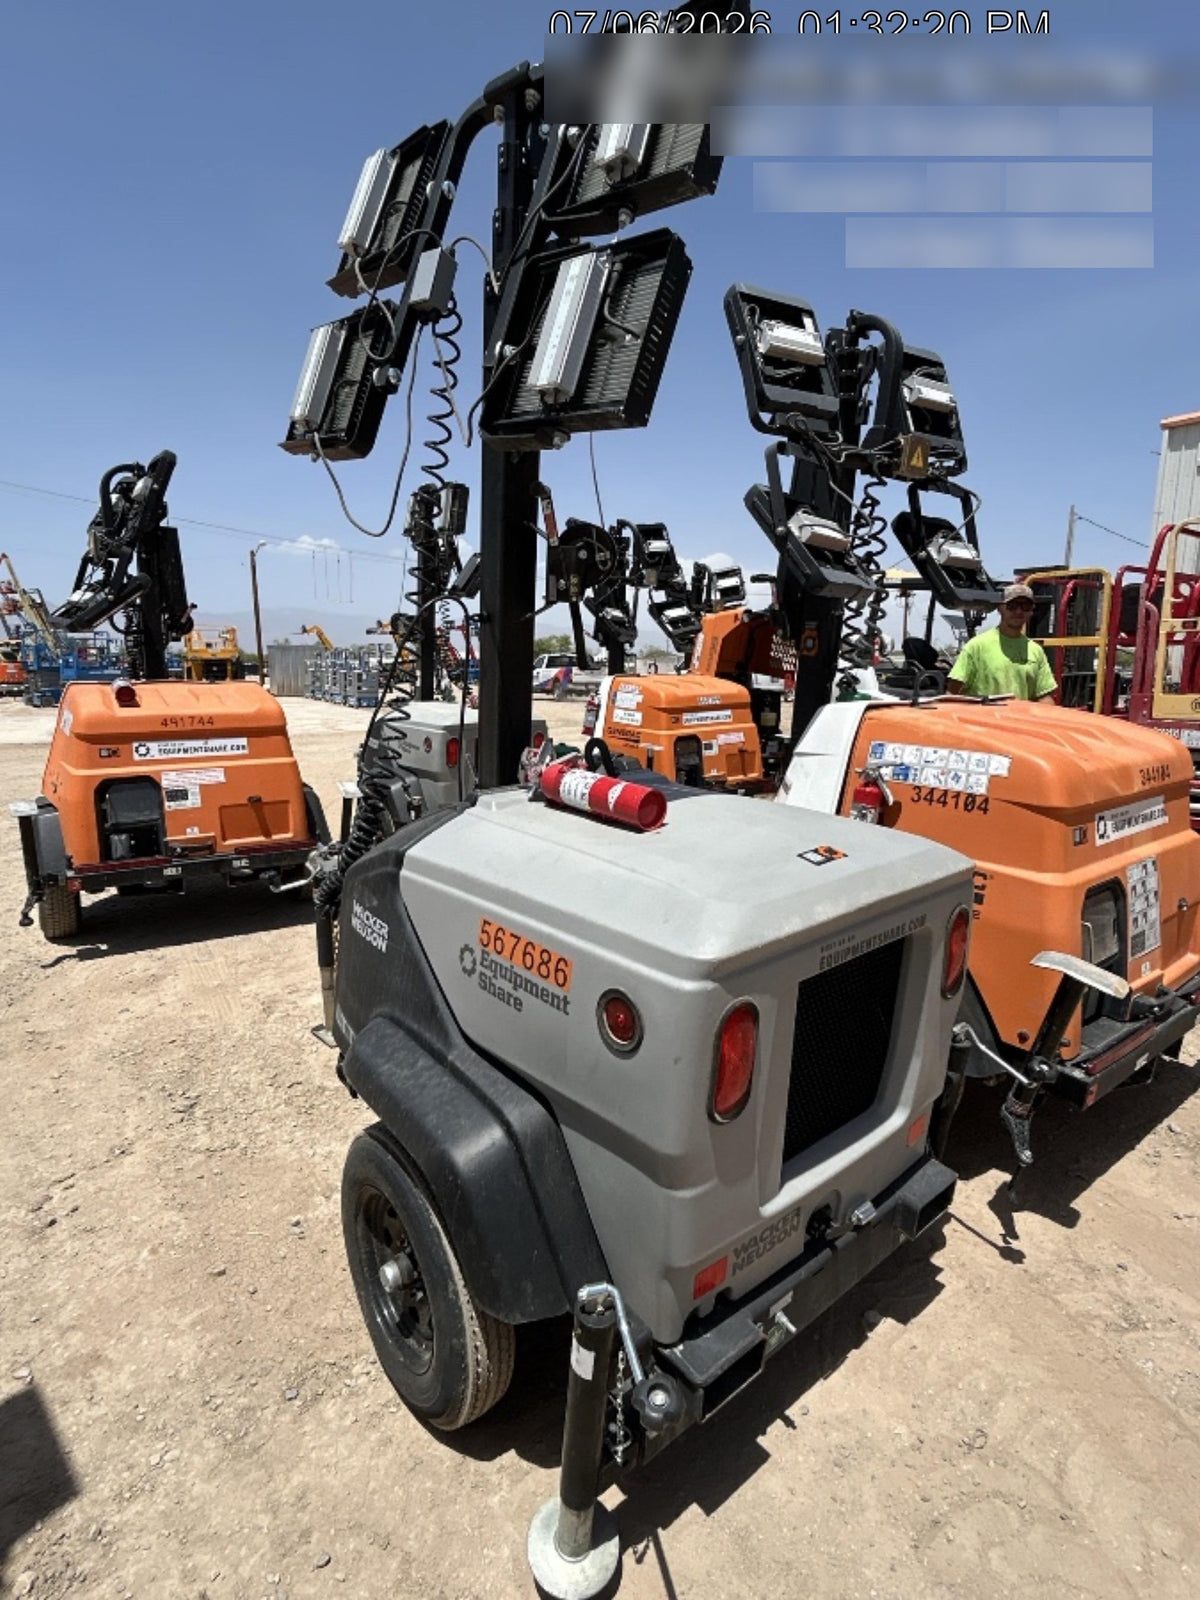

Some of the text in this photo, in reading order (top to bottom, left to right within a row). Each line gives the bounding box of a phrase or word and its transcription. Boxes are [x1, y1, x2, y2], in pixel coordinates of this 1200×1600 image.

[160, 715, 214, 728] 491744
[910, 785, 990, 815] 344104
[352, 899, 388, 939] WACKER
[480, 919, 569, 987] 567686
[478, 971, 523, 1013] Share
[480, 948, 571, 1016] Equipment
[731, 1222, 800, 1277] NEUSON
[732, 1206, 801, 1259] WACKER
